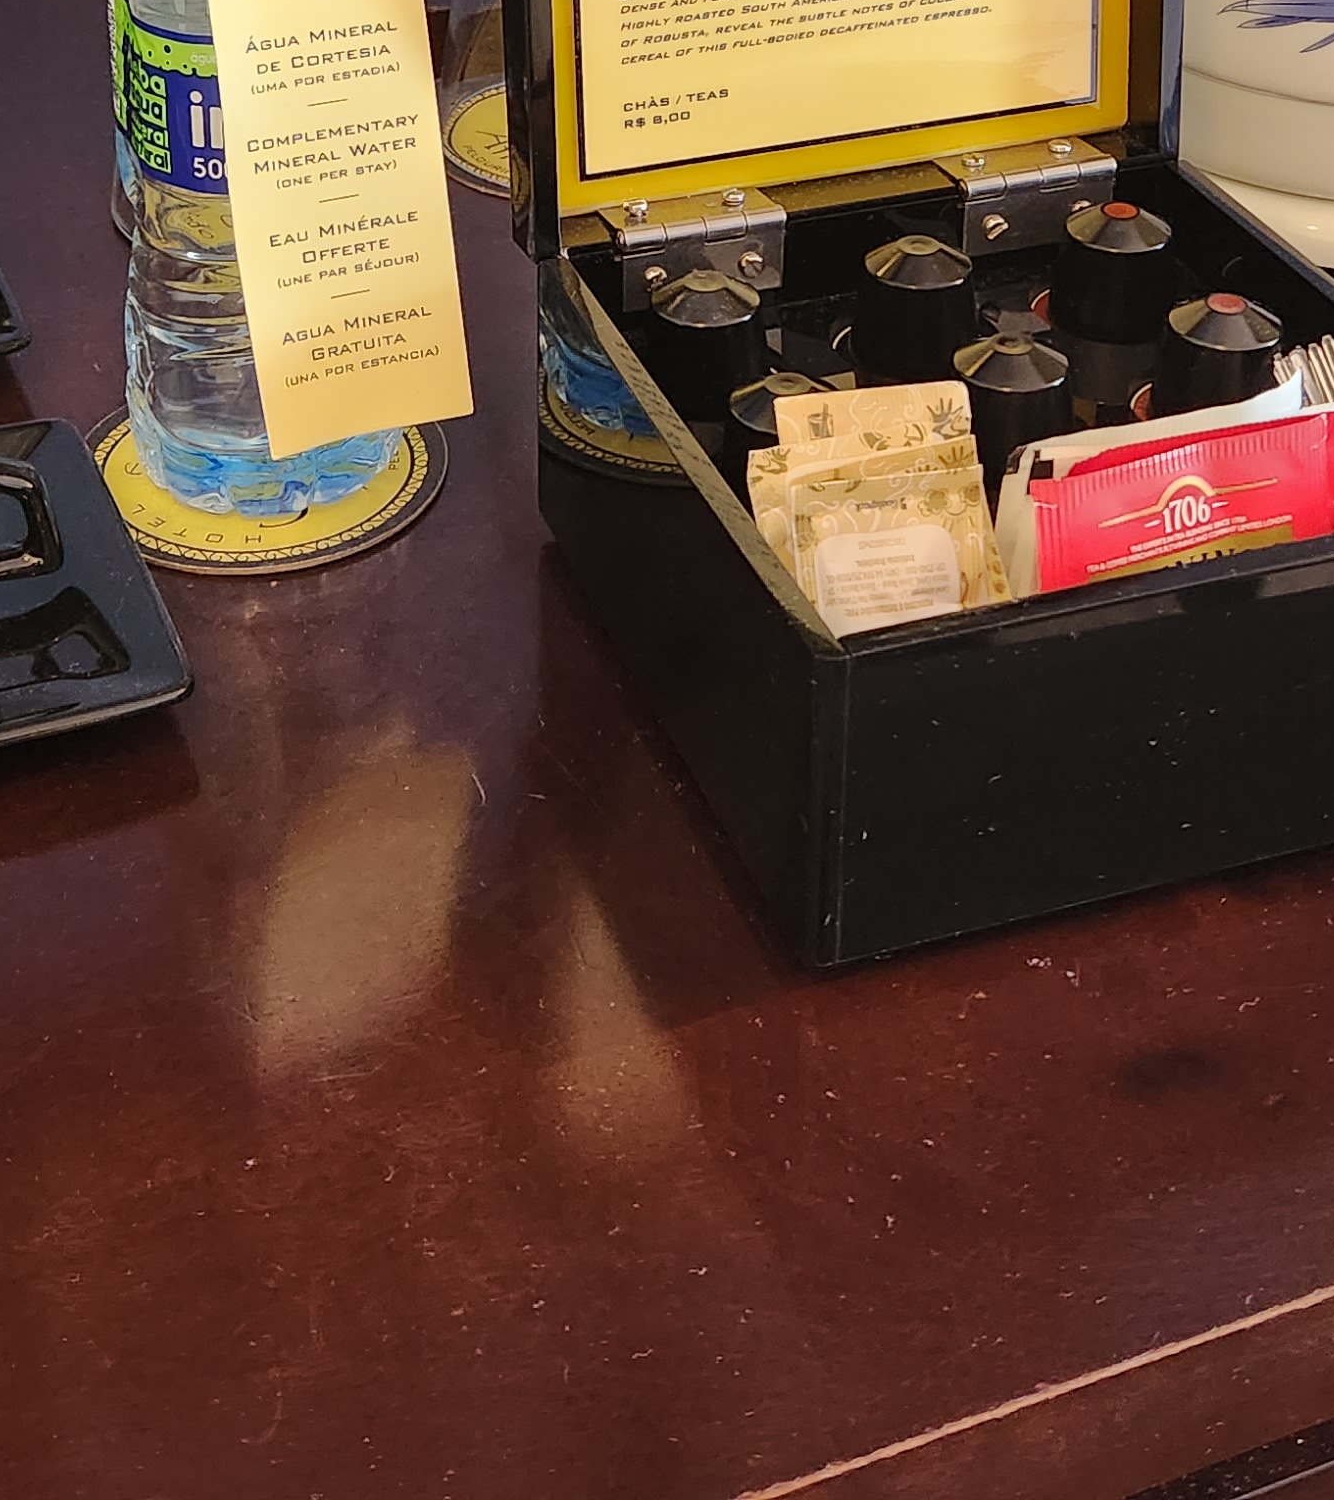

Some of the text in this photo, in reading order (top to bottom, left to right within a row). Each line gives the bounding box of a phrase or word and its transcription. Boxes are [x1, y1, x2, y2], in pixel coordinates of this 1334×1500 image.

[245, 20, 398, 53] ÁGUA MINERAL
[256, 44, 391, 75] DE CORTESIA
[250, 61, 400, 95] (UMA POR ESTADIA)
[623, 95, 669, 112] CHÀS
[685, 88, 728, 102] TEAS
[246, 113, 418, 152] COMPLEMENTARY
[192, 157, 228, 180] 50
[253, 137, 416, 174] MINERAL WATER
[276, 159, 397, 189] (ONE PER STAY)
[269, 210, 418, 247] EAU MINÉRALE
[301, 237, 390, 263] OFFERTE
[277, 251, 419, 288] (UNE PAR SÉJOUR)
[282, 306, 432, 345] AGUA MINERAL
[311, 333, 406, 361] GRATUITA
[285, 344, 439, 388] (UNA POR ESTANCIA)
[1161, 494, 1212, 533] 1706
